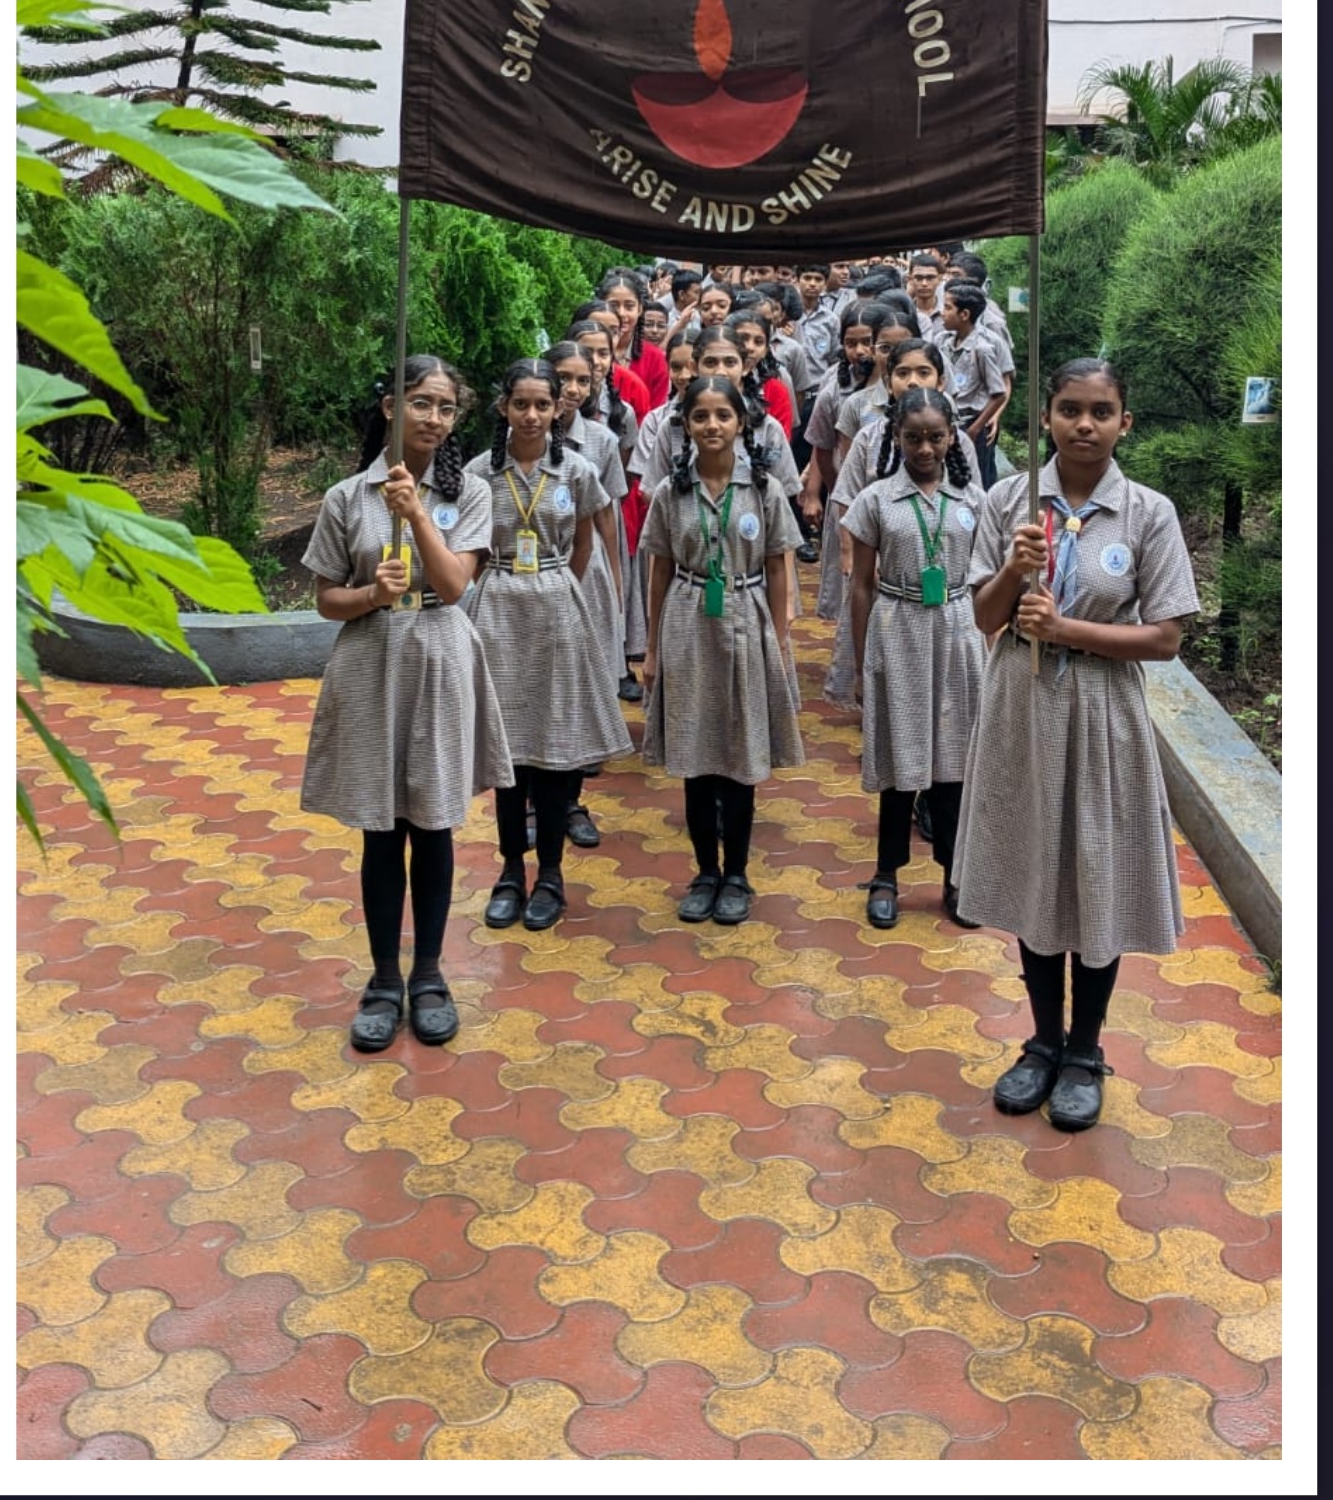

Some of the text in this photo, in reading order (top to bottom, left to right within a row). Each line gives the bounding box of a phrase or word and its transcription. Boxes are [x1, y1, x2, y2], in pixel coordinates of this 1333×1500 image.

[589, 126, 853, 235] ARISE AND SHINE
